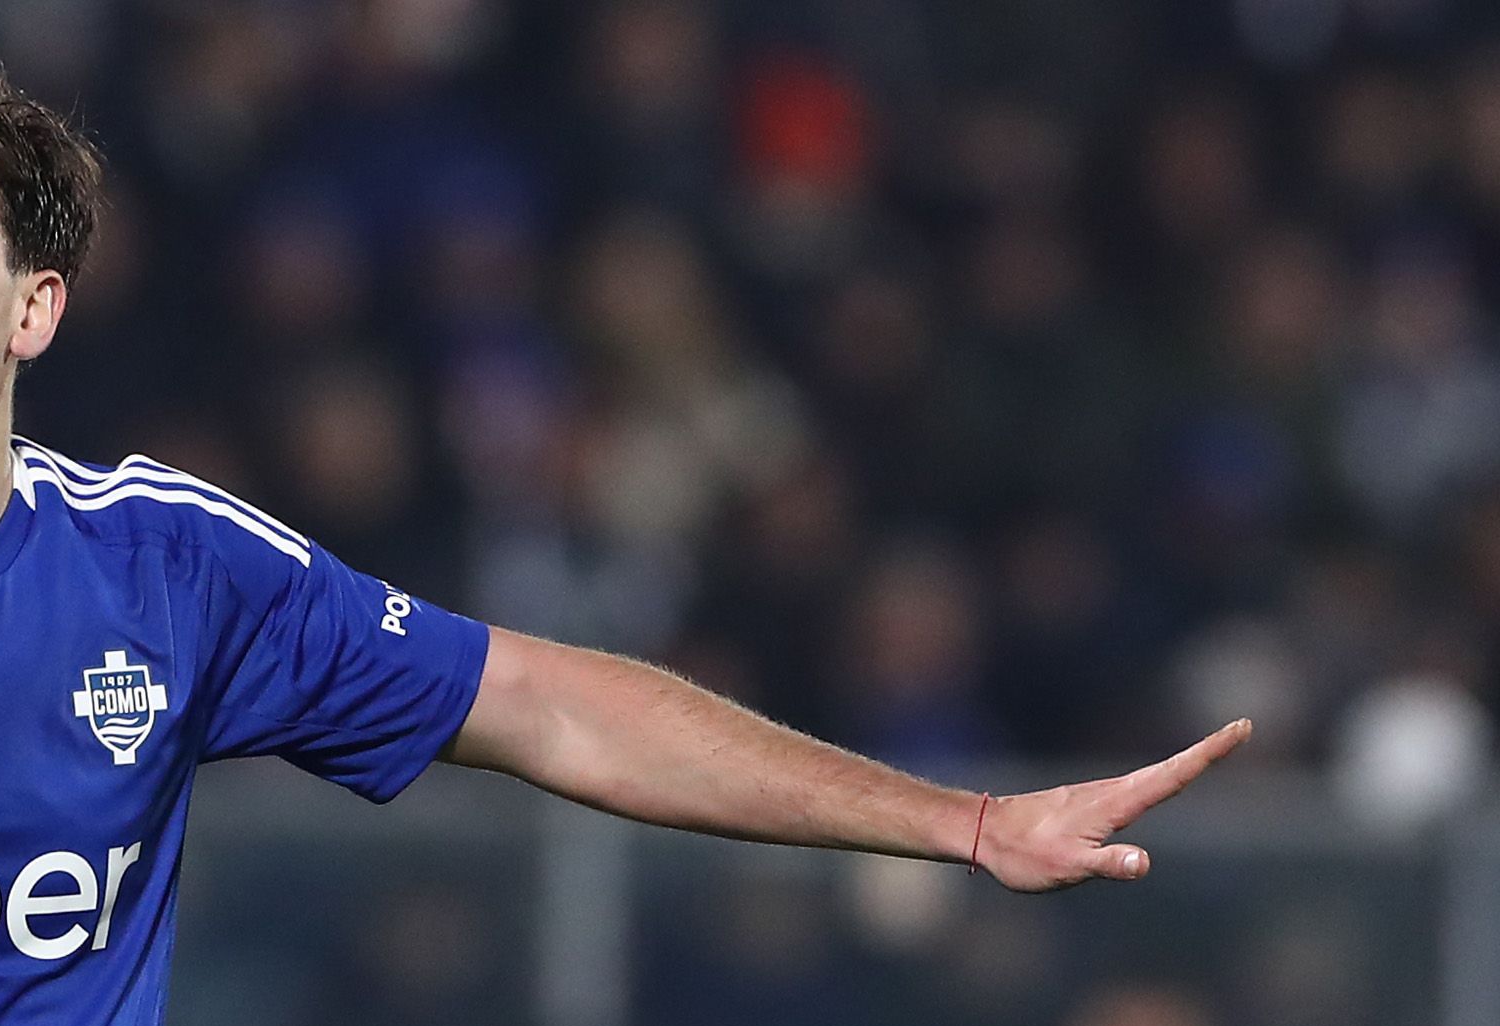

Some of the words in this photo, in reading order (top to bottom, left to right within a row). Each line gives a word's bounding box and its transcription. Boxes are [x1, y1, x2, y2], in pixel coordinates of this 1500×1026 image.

[381, 581, 411, 636] POL
[101, 674, 133, 687] 1907
[93, 686, 148, 715] COMO
